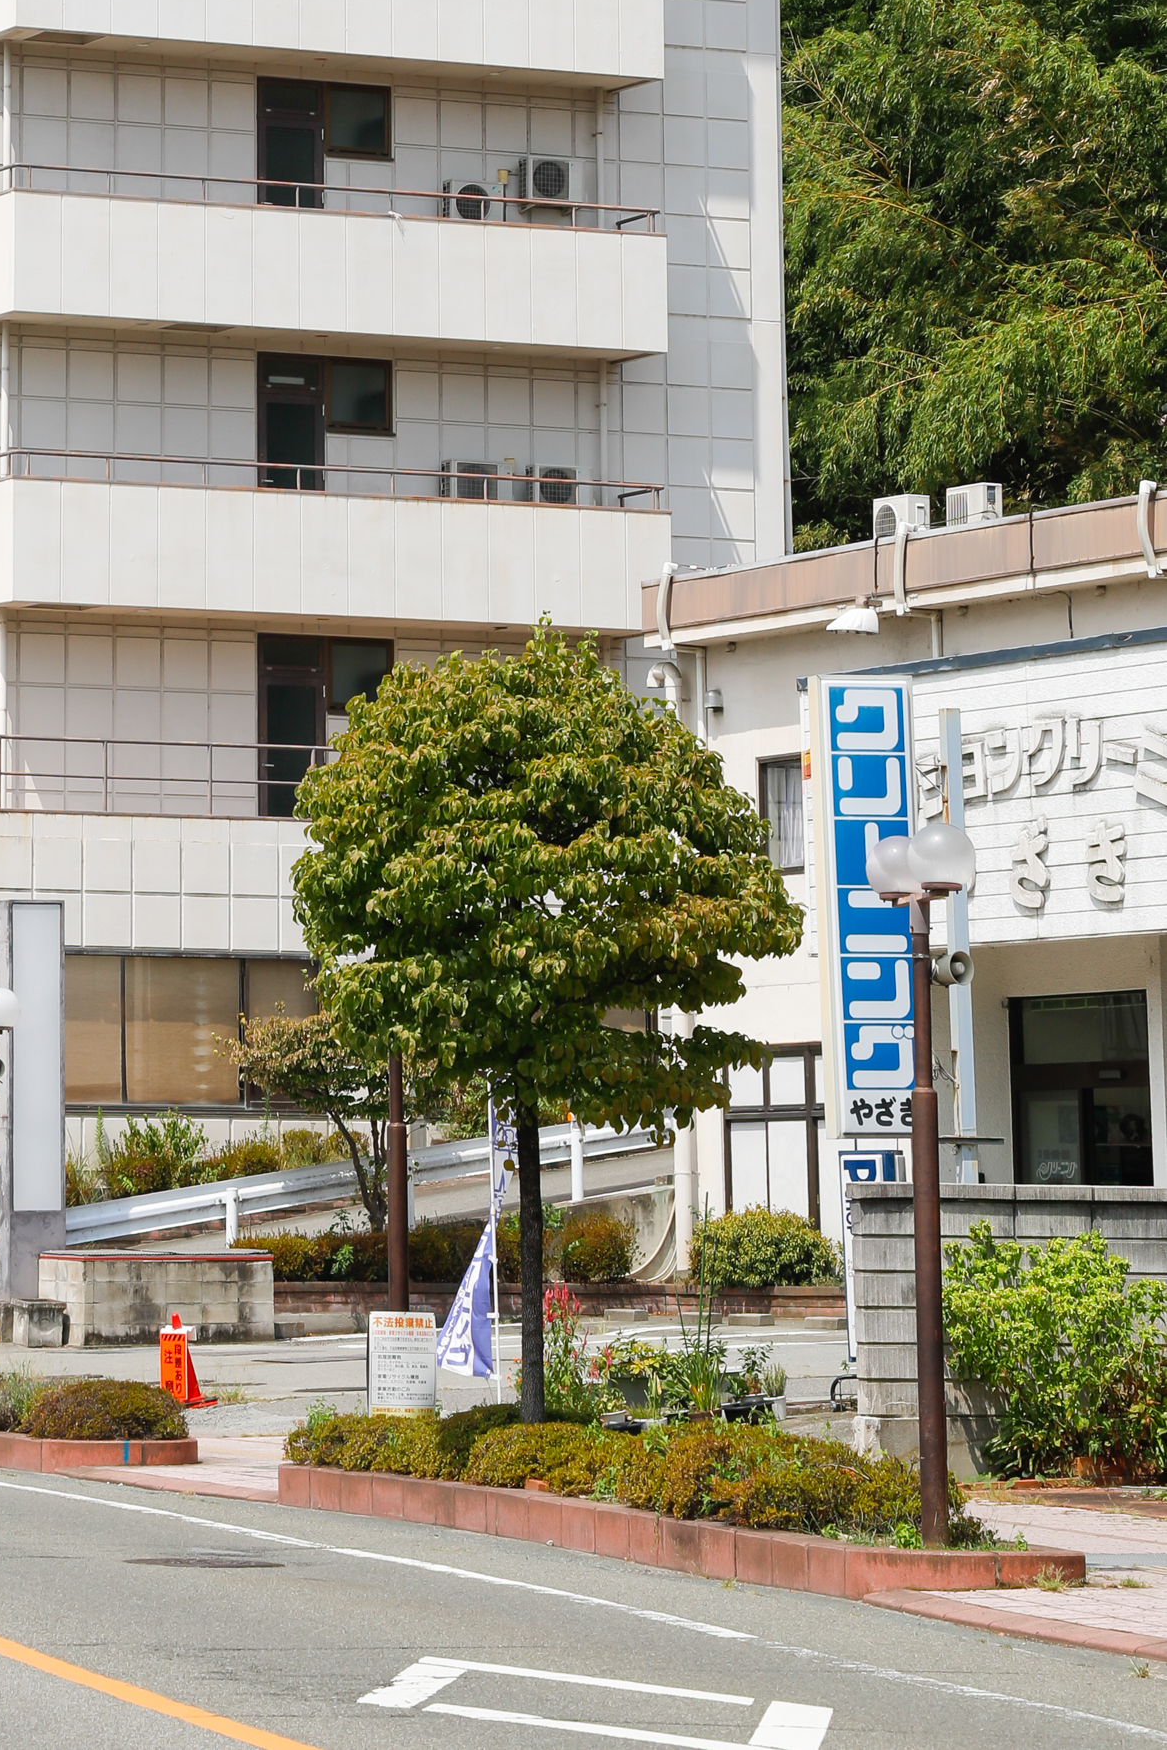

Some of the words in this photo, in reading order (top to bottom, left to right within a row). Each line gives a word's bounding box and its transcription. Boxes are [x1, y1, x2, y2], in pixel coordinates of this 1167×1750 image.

[372, 1316, 434, 1329] 不法投棄禁止
